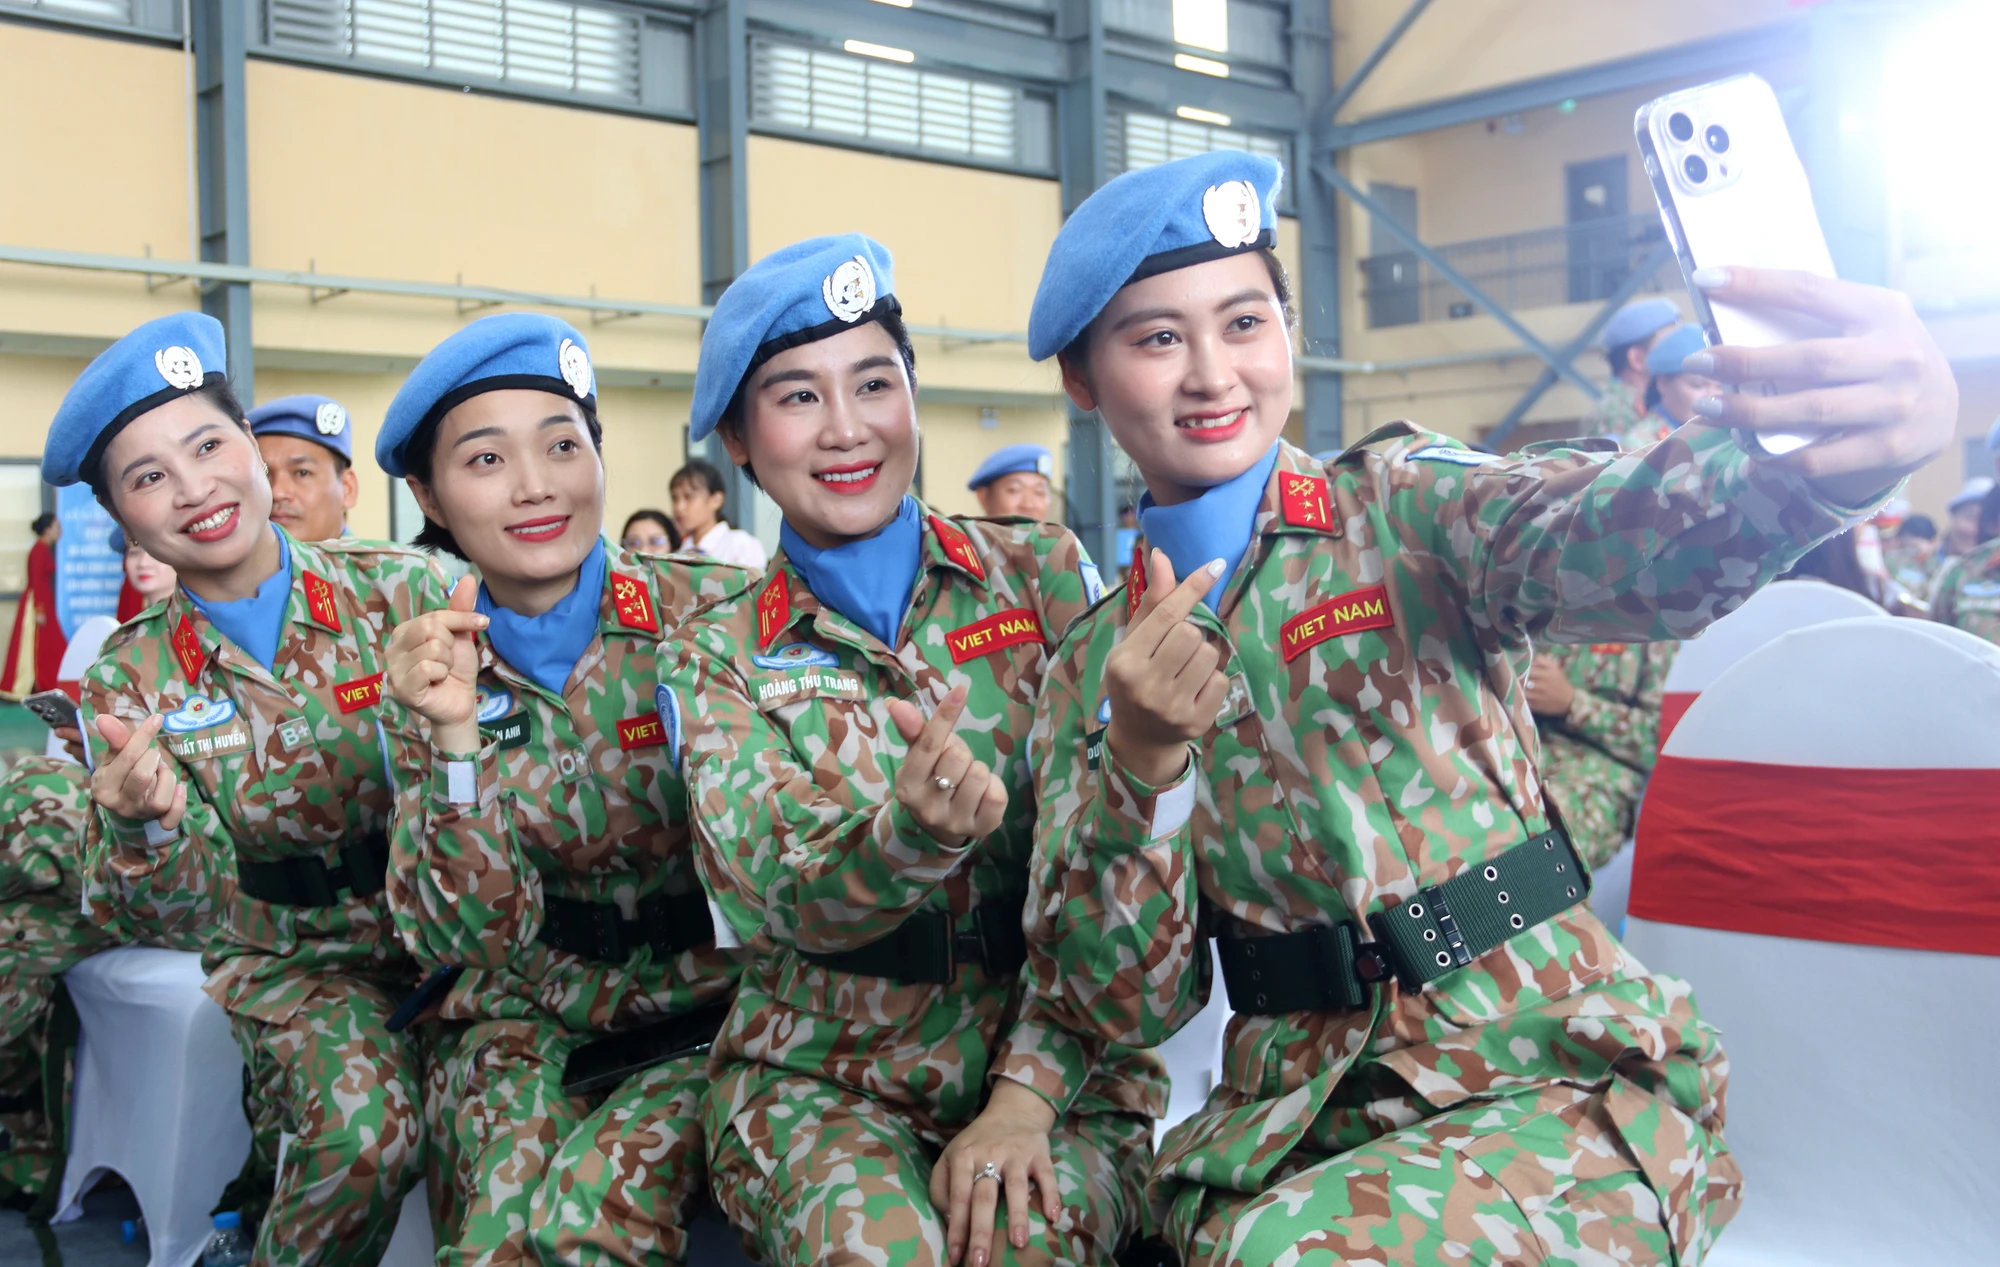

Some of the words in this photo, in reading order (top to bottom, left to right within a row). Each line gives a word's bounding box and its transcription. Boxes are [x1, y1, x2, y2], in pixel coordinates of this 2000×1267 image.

[1286, 614, 1327, 645] VIET
[1332, 598, 1384, 625] NAM
[954, 628, 993, 651] VIET
[998, 618, 1037, 637] NAM
[340, 686, 370, 704] VIET
[758, 678, 797, 700] HOÀNG
[798, 674, 822, 688] THU
[823, 675, 859, 691] TRANG
[281, 724, 310, 748] B+
[505, 724, 521, 741] ANH
[623, 722, 658, 742] VIET
[196, 738, 214, 752] THỊ
